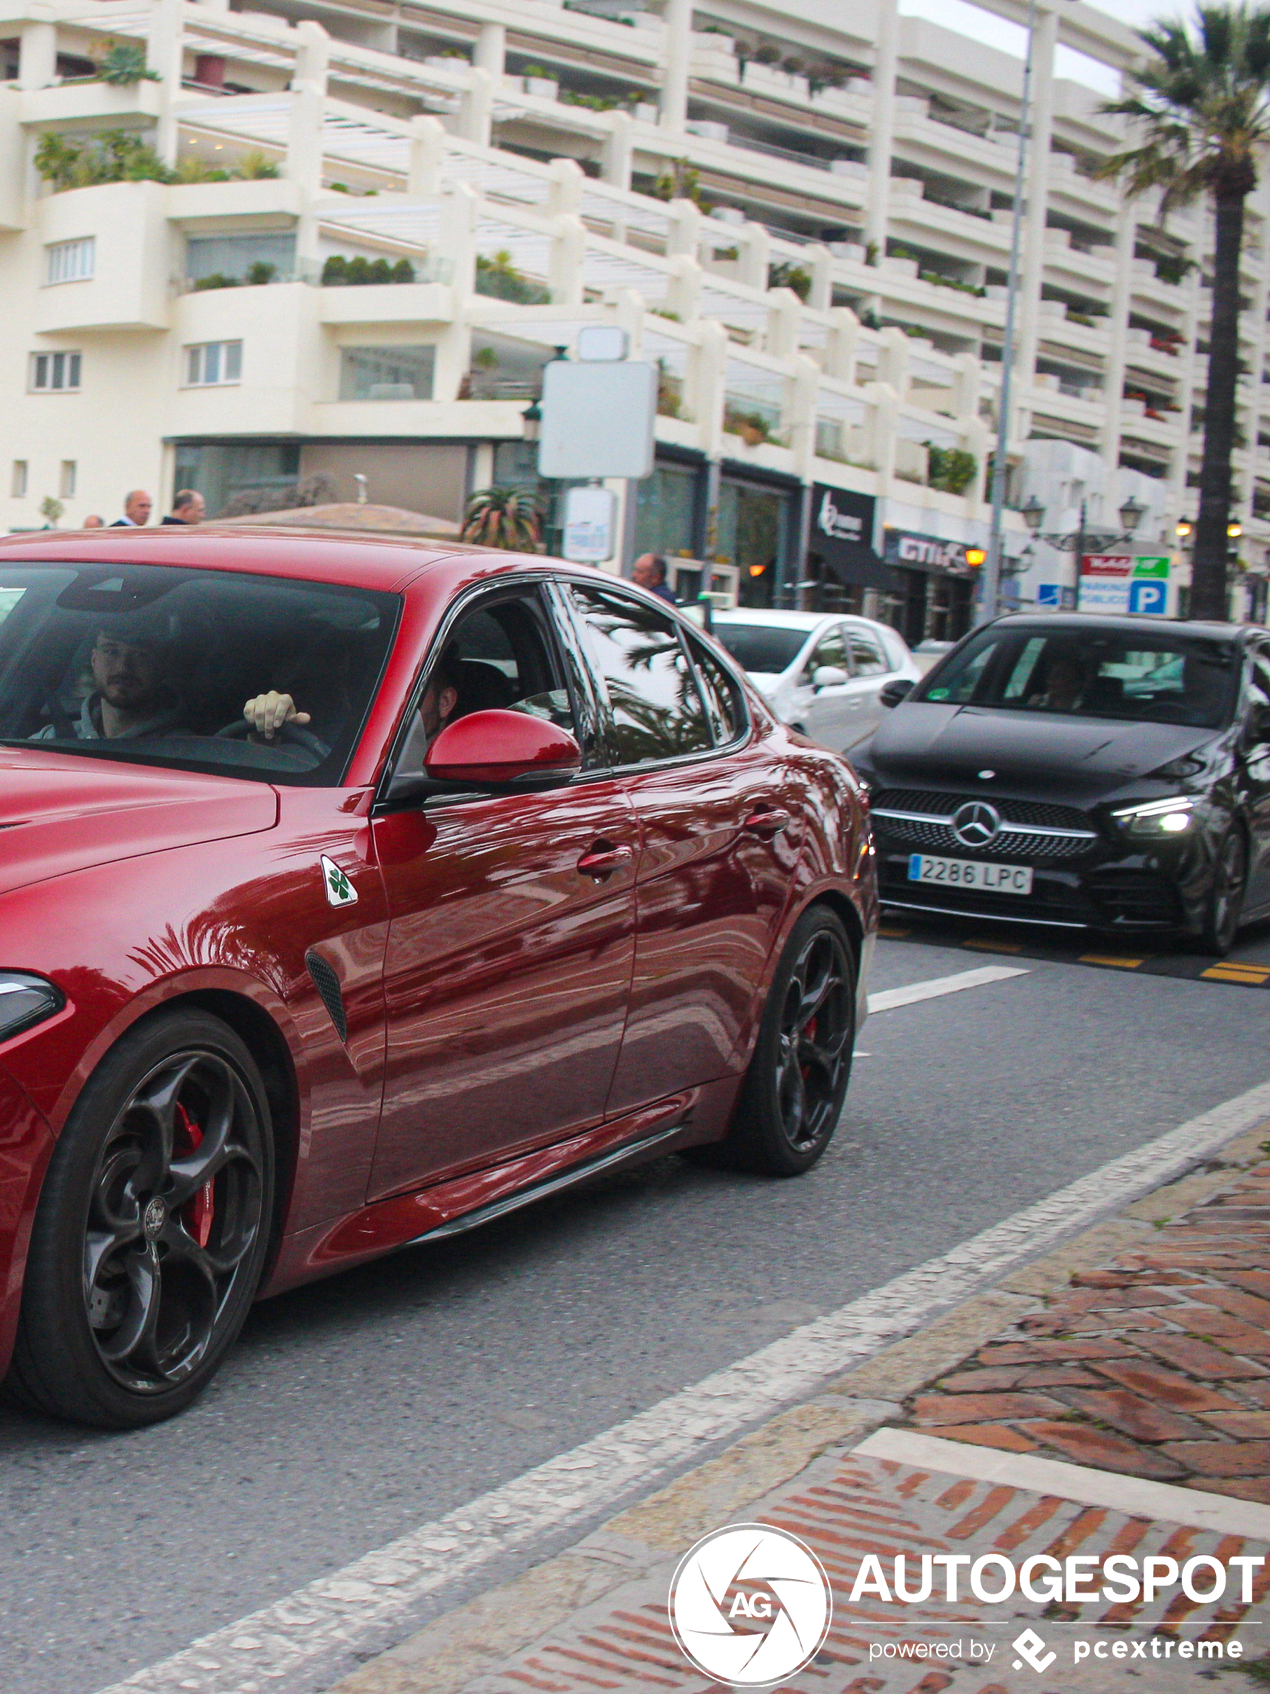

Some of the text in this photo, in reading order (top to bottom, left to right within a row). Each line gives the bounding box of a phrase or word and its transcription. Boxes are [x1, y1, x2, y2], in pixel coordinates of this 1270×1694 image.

[1137, 586, 1161, 612] P
[922, 859, 1026, 889] 2286 LPC
